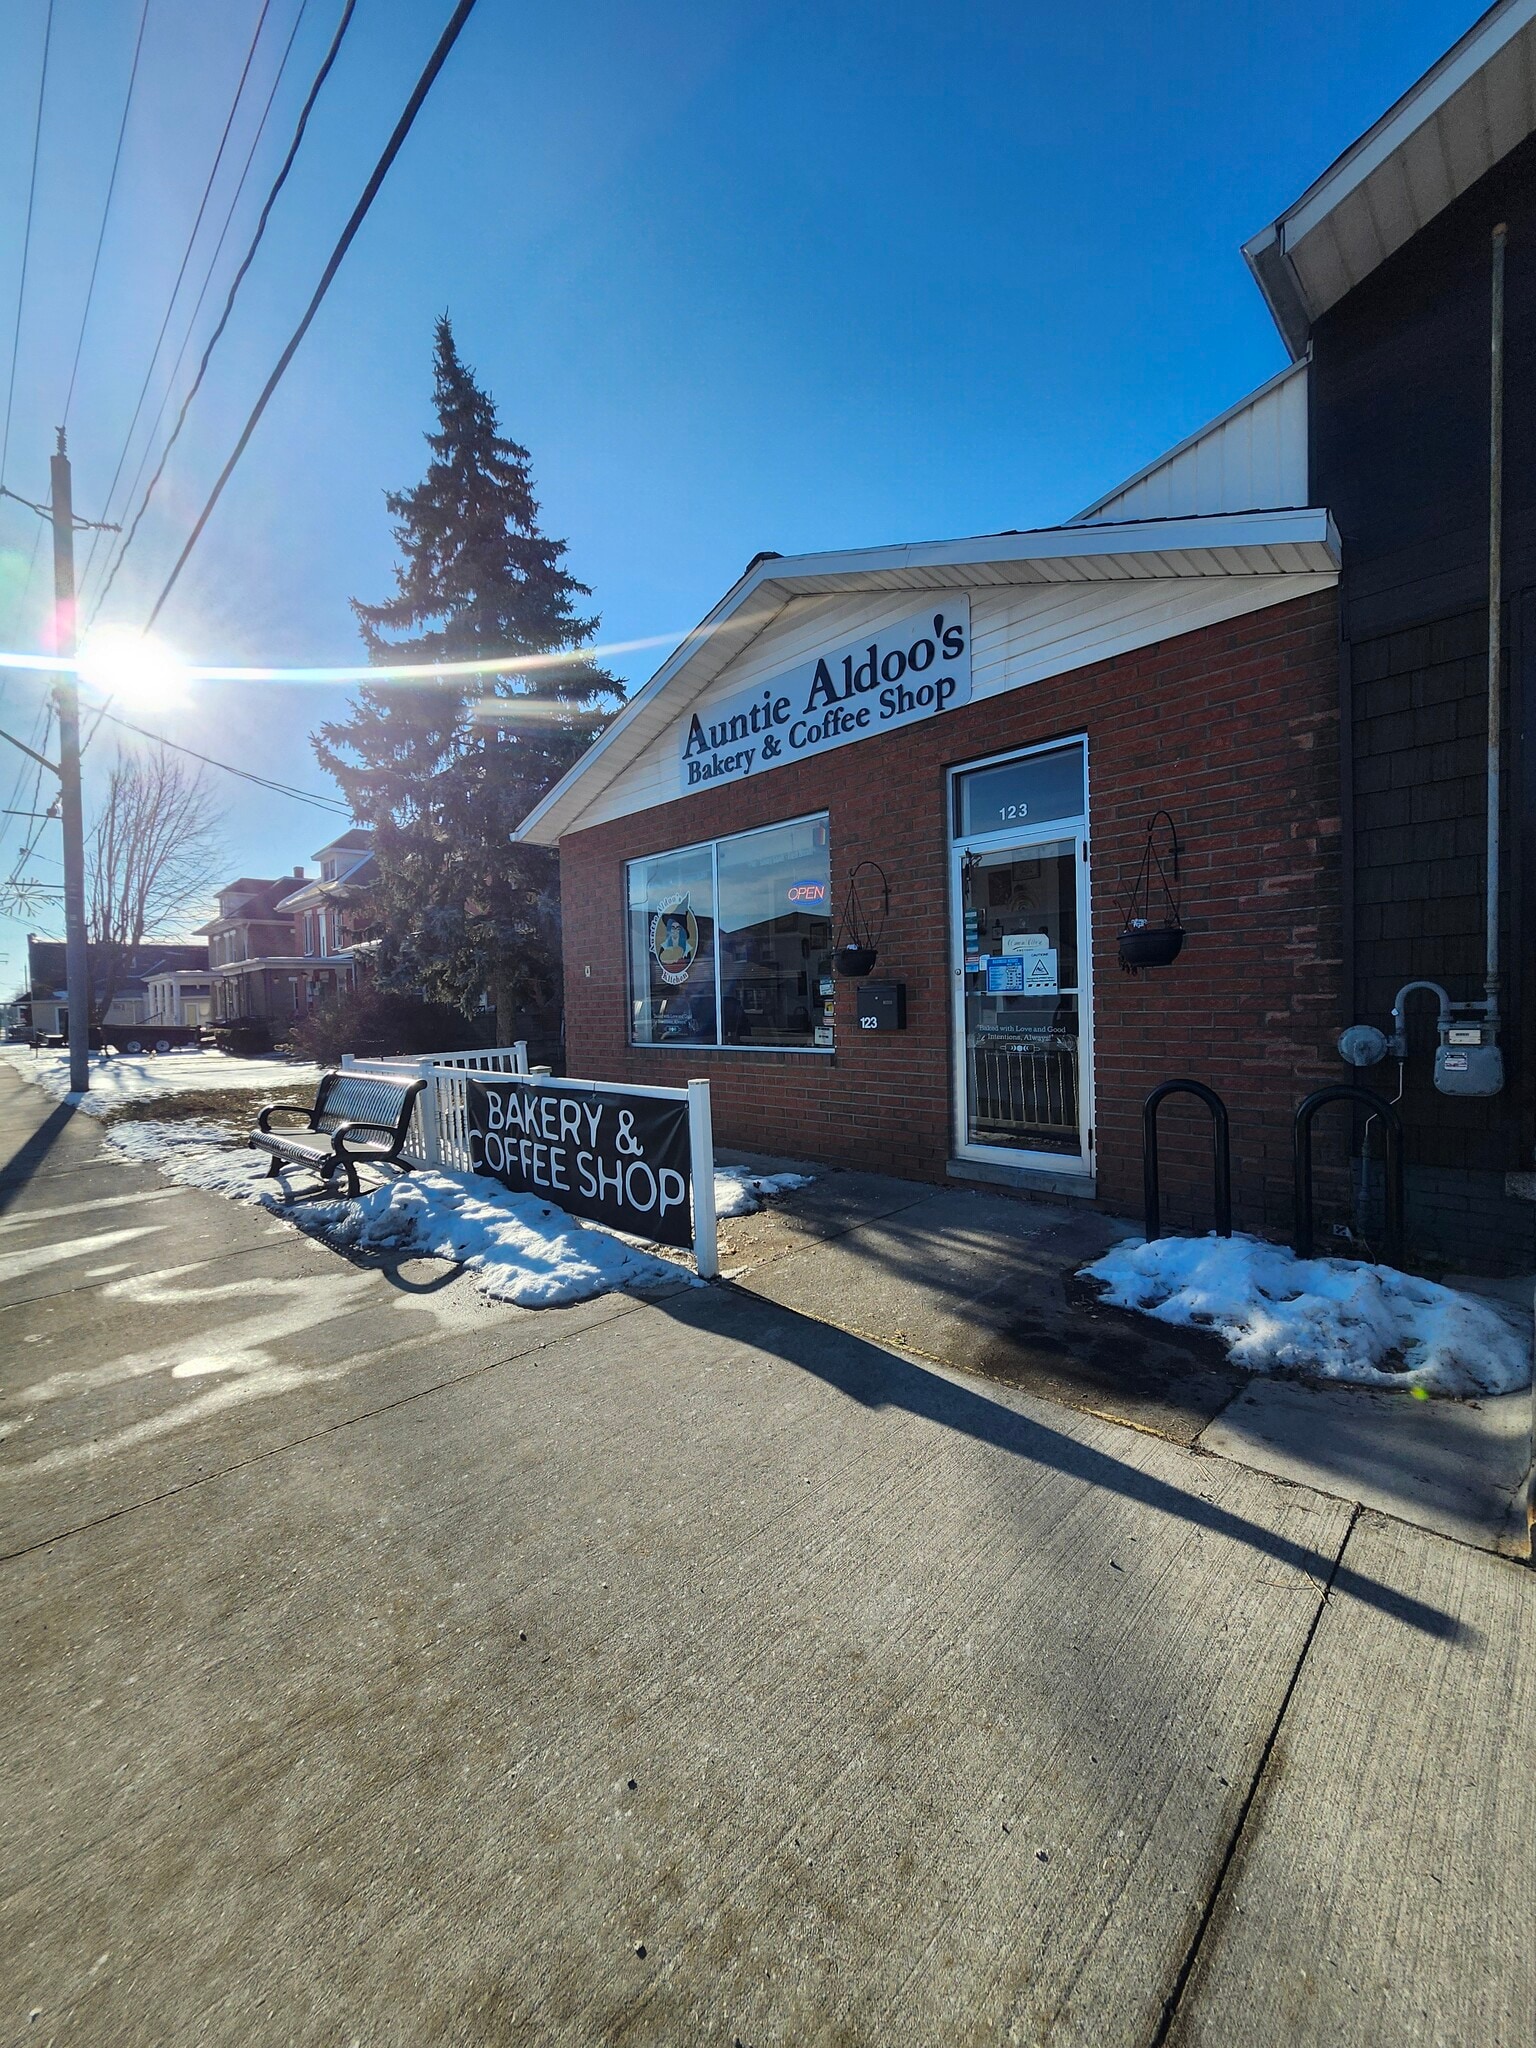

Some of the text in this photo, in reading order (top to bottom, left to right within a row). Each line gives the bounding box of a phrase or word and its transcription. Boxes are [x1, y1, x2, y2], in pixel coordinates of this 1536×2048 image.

[682, 613, 964, 759] Auntie Aldoo's
[687, 677, 956, 785] Bakery & Coffee Shop
[999, 803, 1028, 821] 123
[788, 886, 825, 901] OPEN
[860, 1017, 877, 1029] 123
[486, 1091, 644, 1156] BAKERY &
[468, 1129, 685, 1218] COFFEE SHOP
